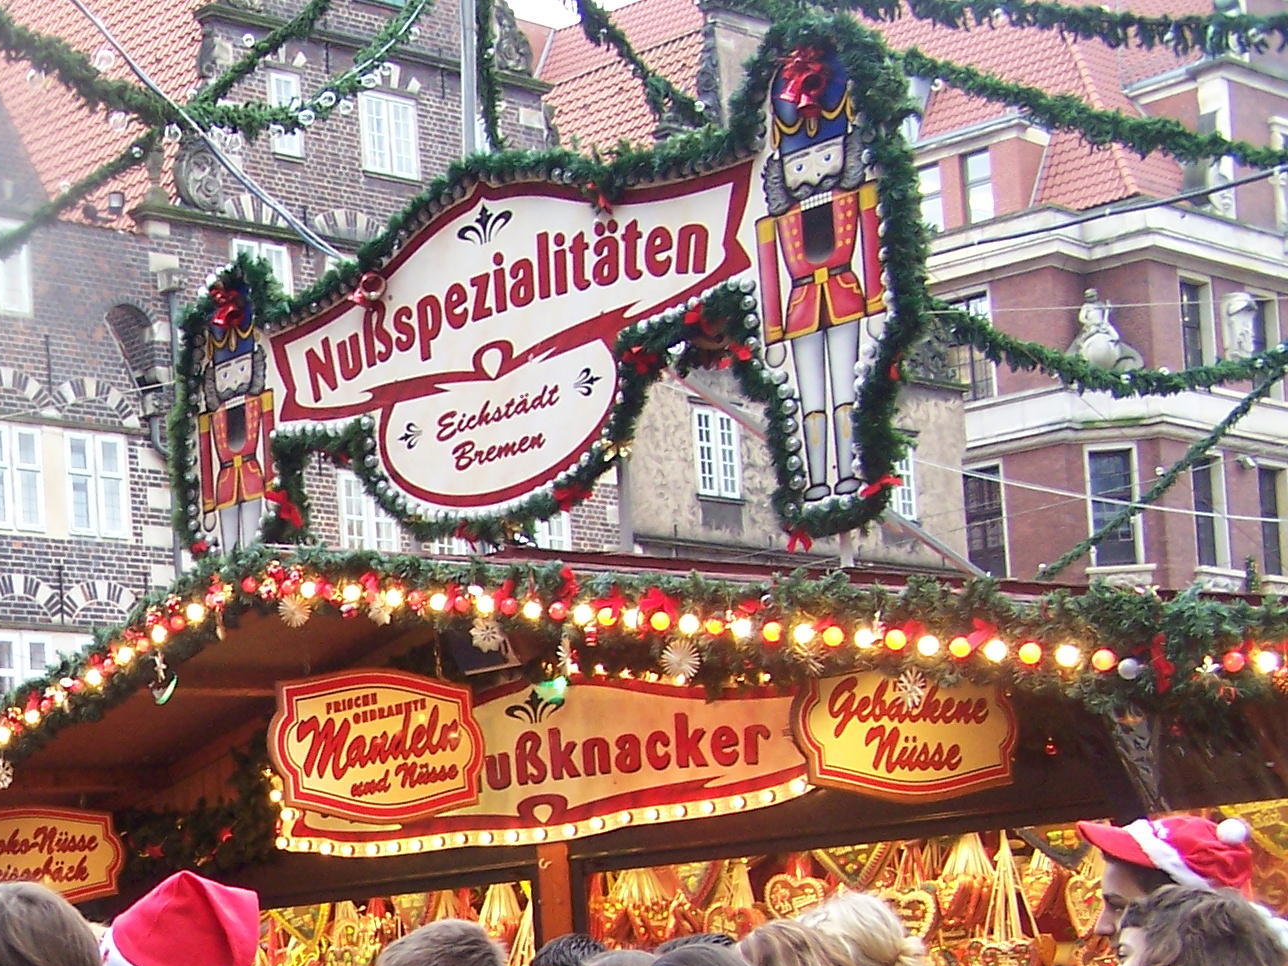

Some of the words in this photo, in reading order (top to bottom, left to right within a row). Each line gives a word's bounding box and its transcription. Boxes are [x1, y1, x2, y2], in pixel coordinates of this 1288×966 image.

[305, 219, 708, 404] Nußspezialitäten
[436, 384, 561, 442] Eichstädt
[452, 432, 546, 471] Bremen
[828, 676, 990, 739] Gebackene
[297, 705, 461, 780] Mandeln
[480, 712, 772, 793] ußknacker
[864, 725, 963, 774] Nüsse
[350, 768, 392, 798] und
[394, 761, 460, 789] Nüsse
